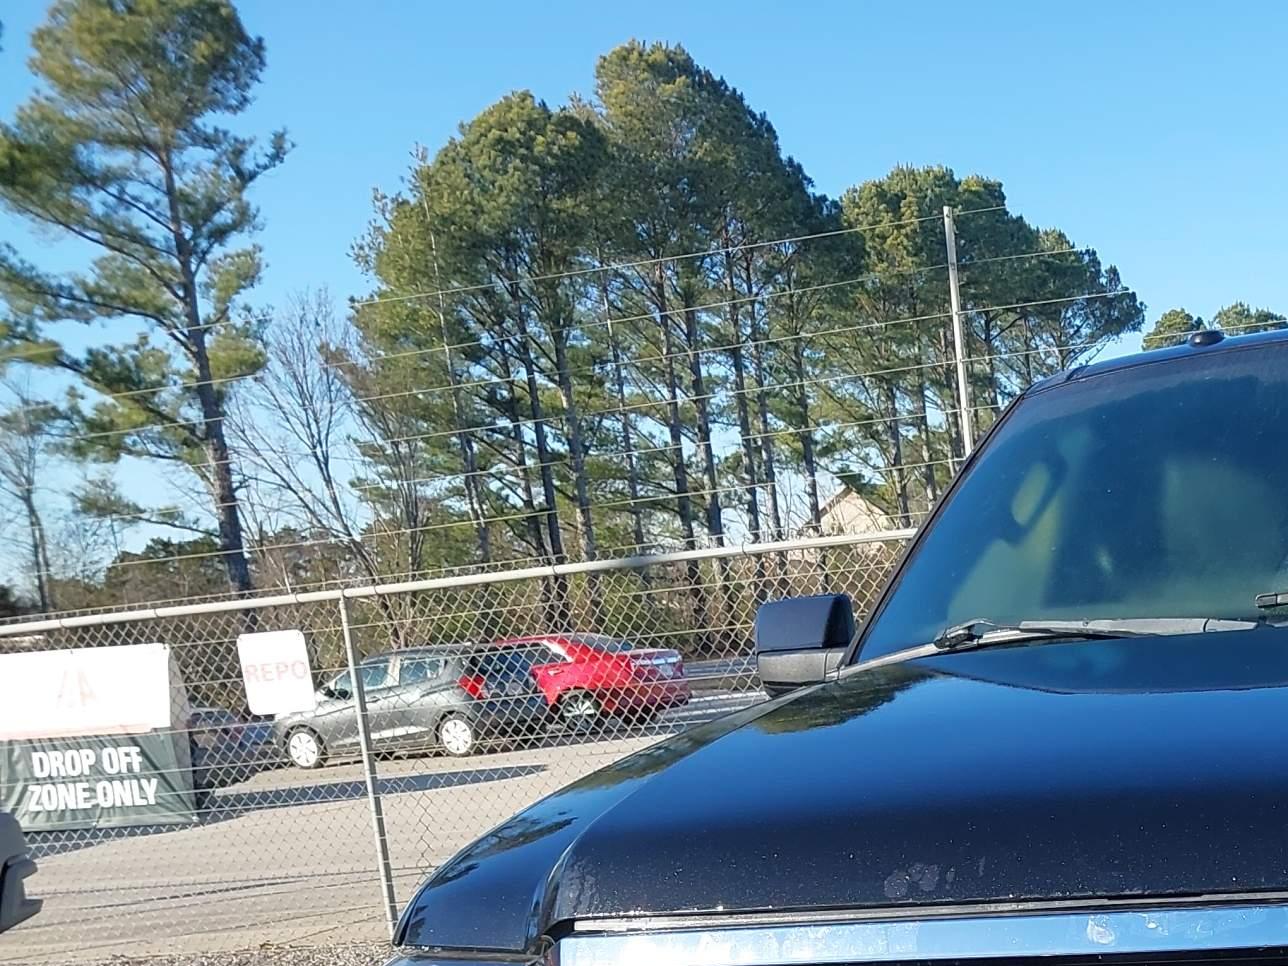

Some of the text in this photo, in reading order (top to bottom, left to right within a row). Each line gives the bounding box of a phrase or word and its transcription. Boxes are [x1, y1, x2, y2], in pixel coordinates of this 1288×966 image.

[245, 660, 308, 682] REPO
[31, 746, 143, 779] DROP OFF
[27, 778, 158, 812] ZONE ONLY
